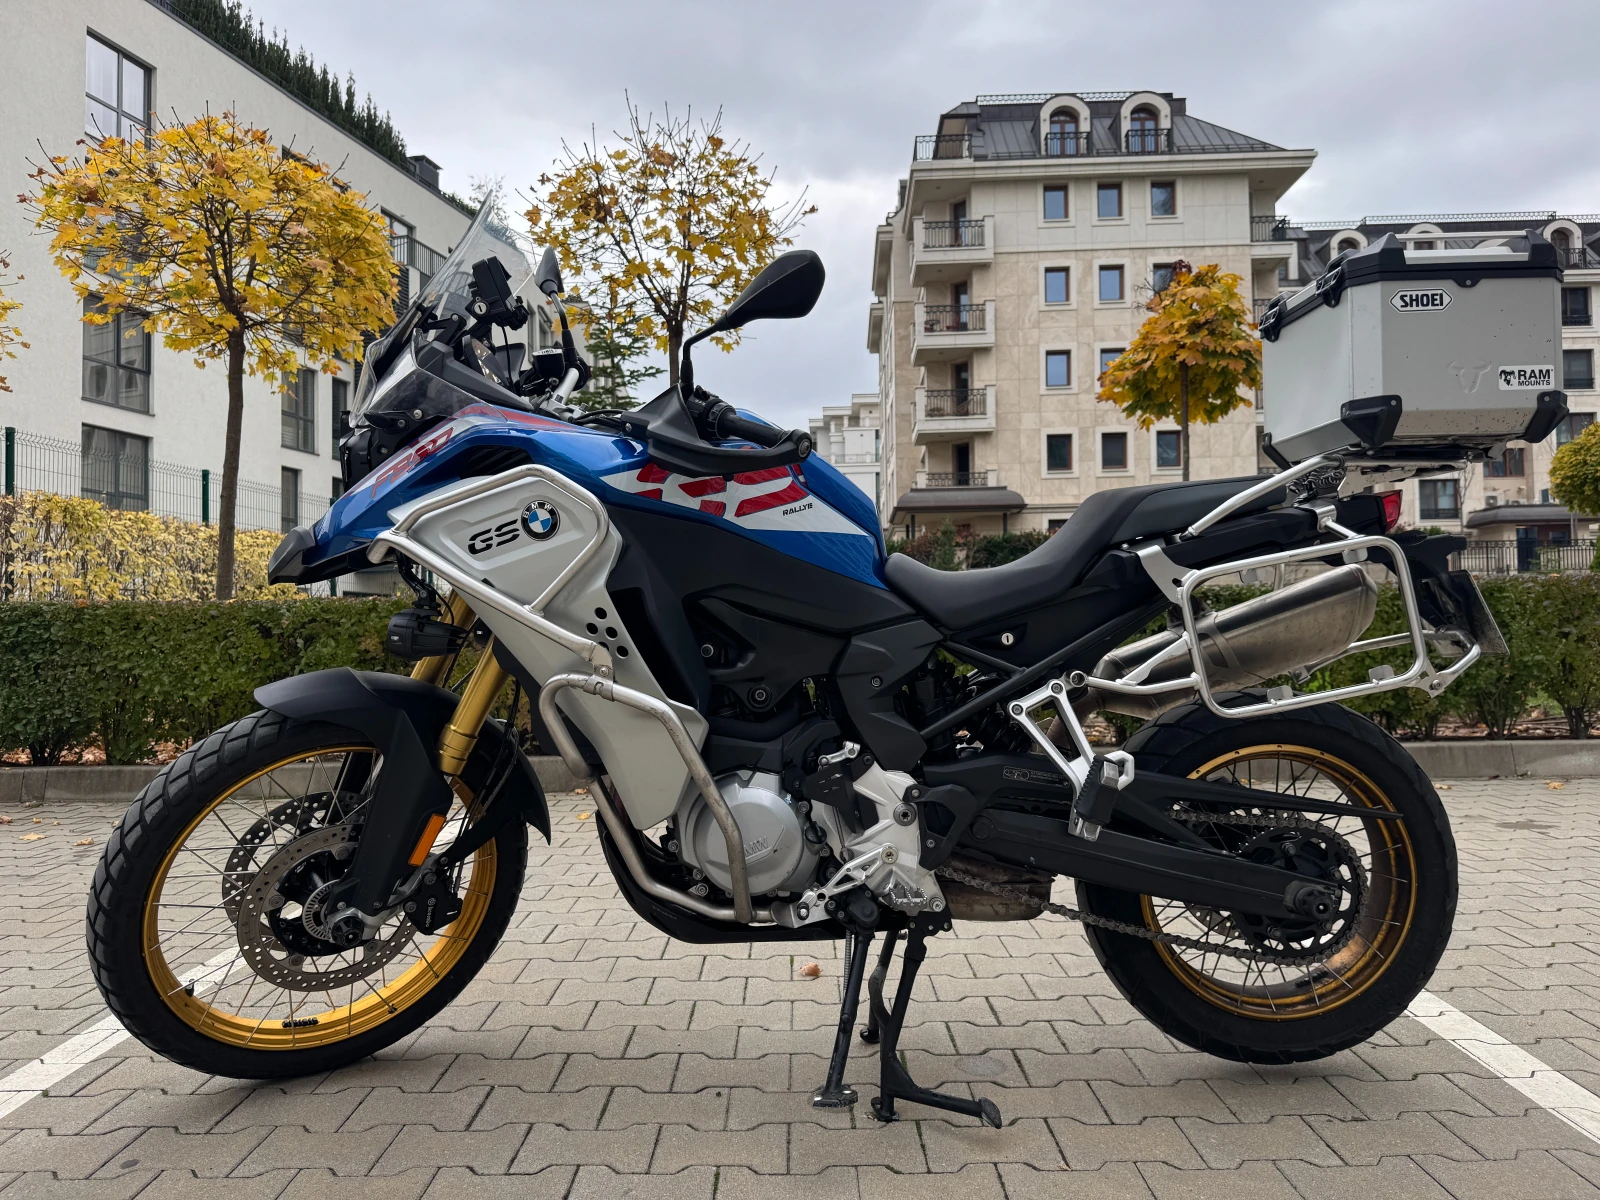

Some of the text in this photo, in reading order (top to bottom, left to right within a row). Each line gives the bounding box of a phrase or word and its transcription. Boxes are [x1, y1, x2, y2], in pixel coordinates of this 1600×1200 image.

[1399, 293, 1444, 308] SHOEI
[1517, 368, 1551, 381] RAM
[1517, 379, 1551, 387] MOUNTS
[782, 502, 813, 516] RALLYE
[467, 518, 521, 555] GS
[743, 836, 769, 858] MW
[425, 906, 434, 928] brembo
